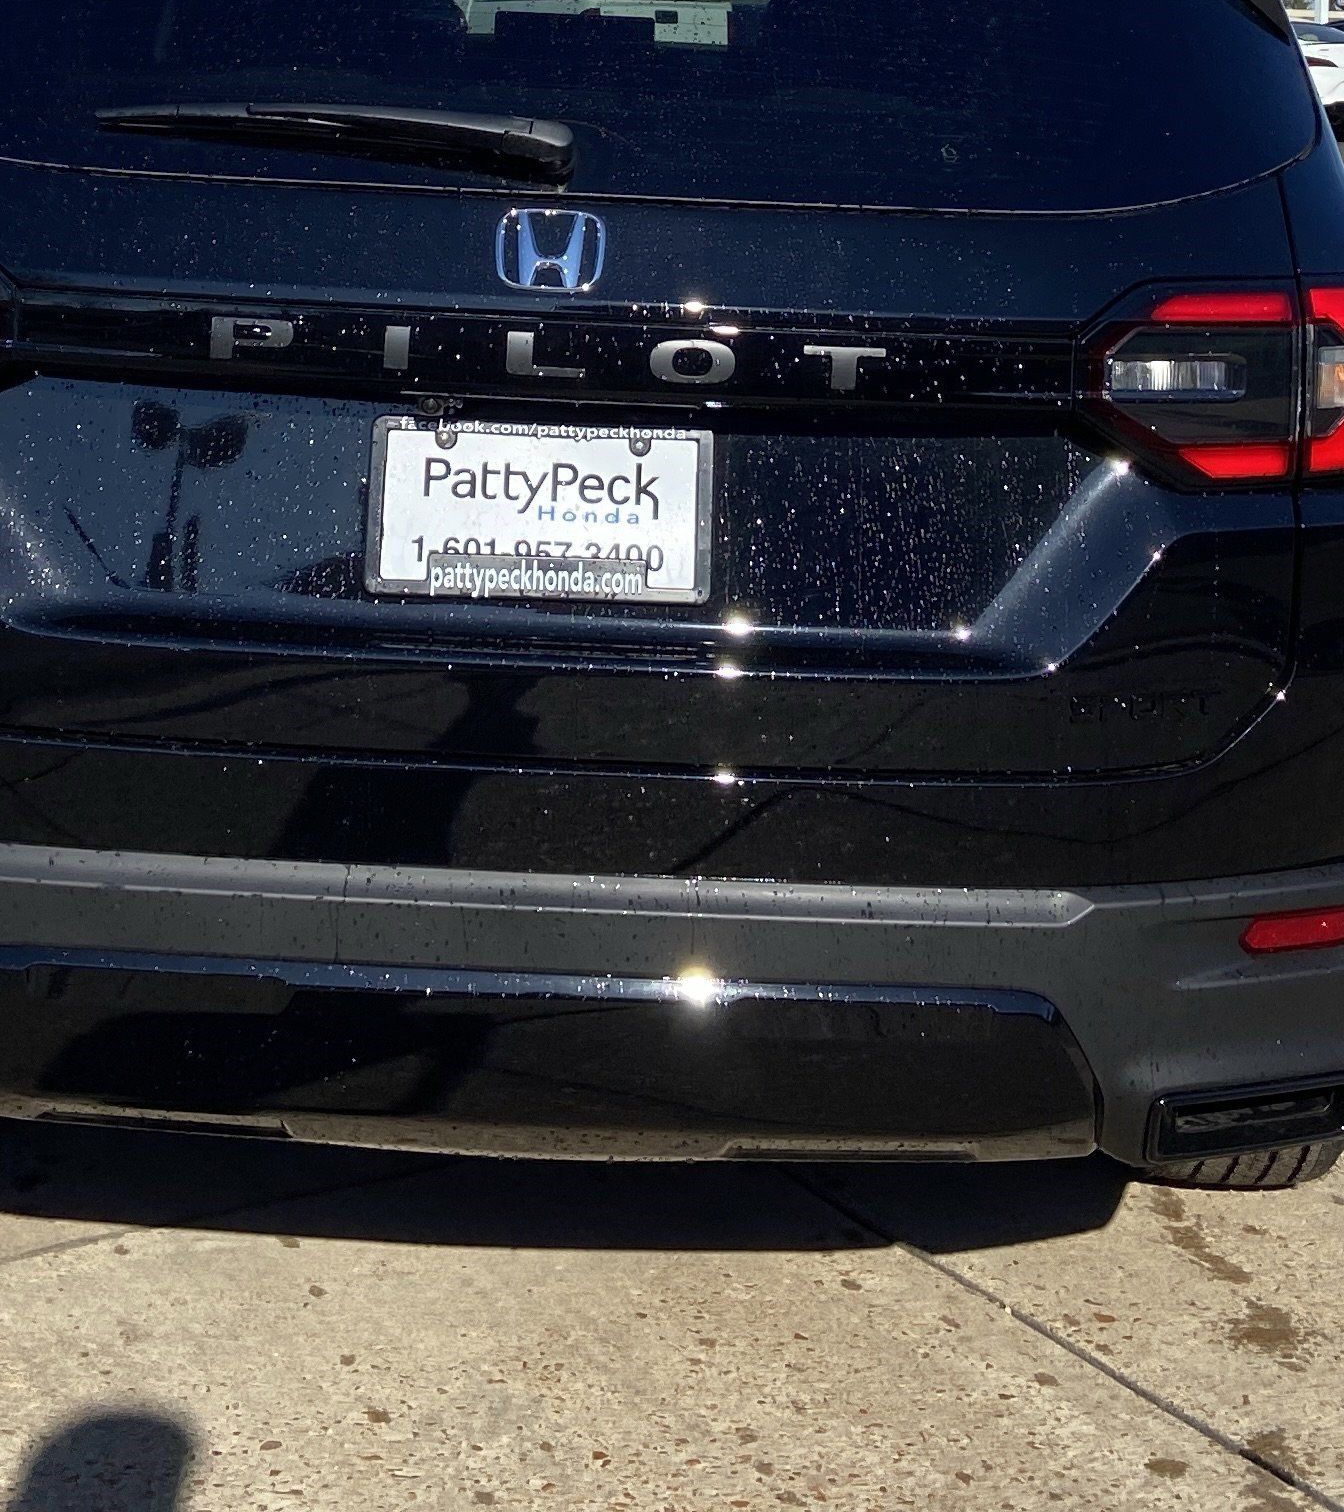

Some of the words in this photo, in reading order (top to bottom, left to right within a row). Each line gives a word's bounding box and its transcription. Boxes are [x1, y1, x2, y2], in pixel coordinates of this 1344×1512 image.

[209, 316, 887, 390] PILOT
[423, 456, 660, 520] PattyPeck
[537, 505, 640, 525] Honda
[429, 559, 643, 598] pattypeckhonda.com
